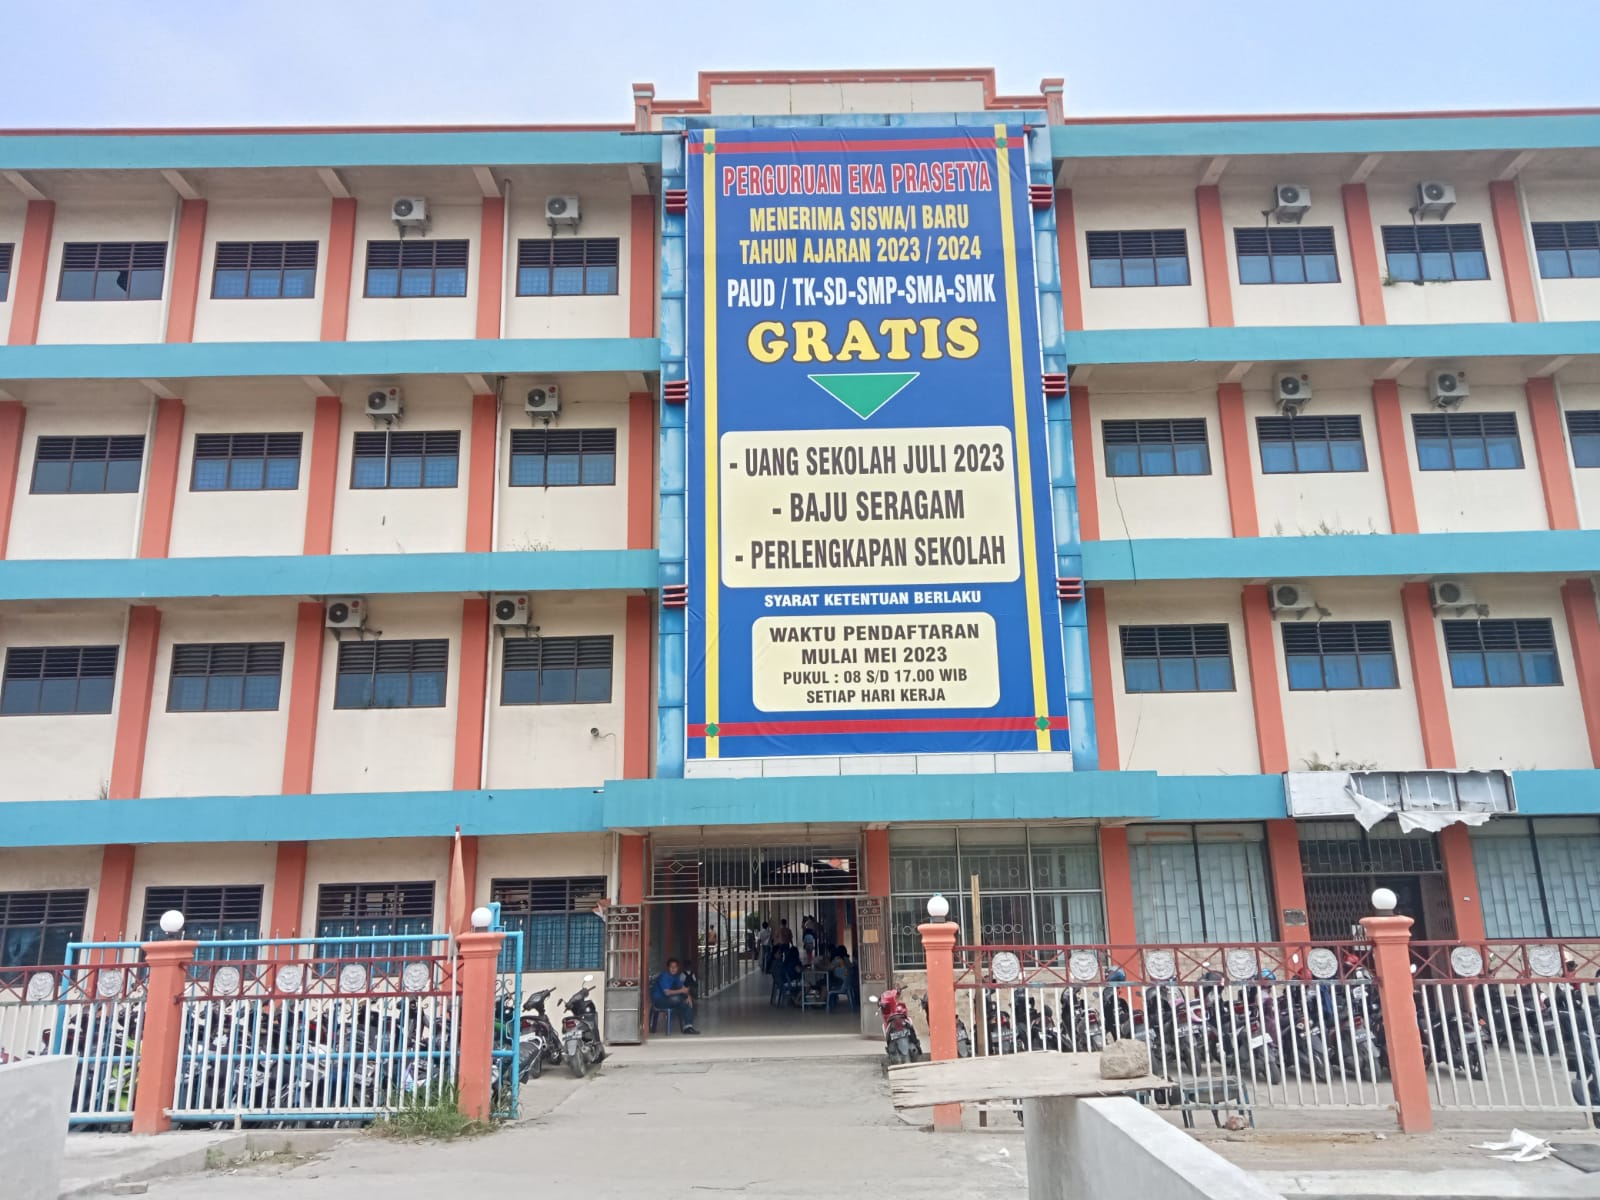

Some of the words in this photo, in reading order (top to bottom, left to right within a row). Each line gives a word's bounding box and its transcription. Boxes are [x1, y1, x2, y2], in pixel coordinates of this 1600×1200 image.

[723, 165, 842, 196] PERGURUAN
[849, 164, 886, 194] EKA
[891, 161, 992, 193] PRASETYA
[750, 207, 844, 232] MENERIMA
[850, 206, 916, 232] SISWA/I
[922, 204, 969, 228] BARU
[739, 238, 797, 264] TAHUN
[803, 238, 871, 263] AJARAN
[876, 237, 921, 262] 2023
[937, 235, 982, 260] 2024
[727, 278, 775, 307] PAUD
[792, 273, 996, 306] TK-SD-SMP-SMA-SMK
[747, 317, 980, 363] GRATIS
[745, 448, 799, 476] UANG
[806, 446, 896, 475] SEKOLAH
[903, 445, 947, 474] JULI
[954, 443, 1004, 472] 2023
[790, 492, 848, 522] BAJU
[856, 489, 964, 521] SERAGAM
[751, 538, 907, 569] PERLENGKAPAN
[914, 536, 1005, 566] SEKOLAH
[764, 594, 819, 607] SYARAT
[824, 592, 909, 606] KETENTUAN
[914, 591, 981, 604] BERLAKU
[770, 627, 836, 642] WAKTU
[843, 624, 979, 641] PENDAFTARAN
[802, 648, 858, 664] MULAI
[864, 648, 897, 663] MEI
[903, 647, 947, 662] 2023
[783, 671, 829, 685] PUKUL
[844, 670, 861, 684] 08
[866, 670, 889, 684] S/D
[895, 669, 935, 683] 17.00
[939, 668, 967, 682] WIB
[806, 690, 856, 703] SETIAP
[862, 689, 895, 702] HARI
[901, 688, 945, 702] KERJA
